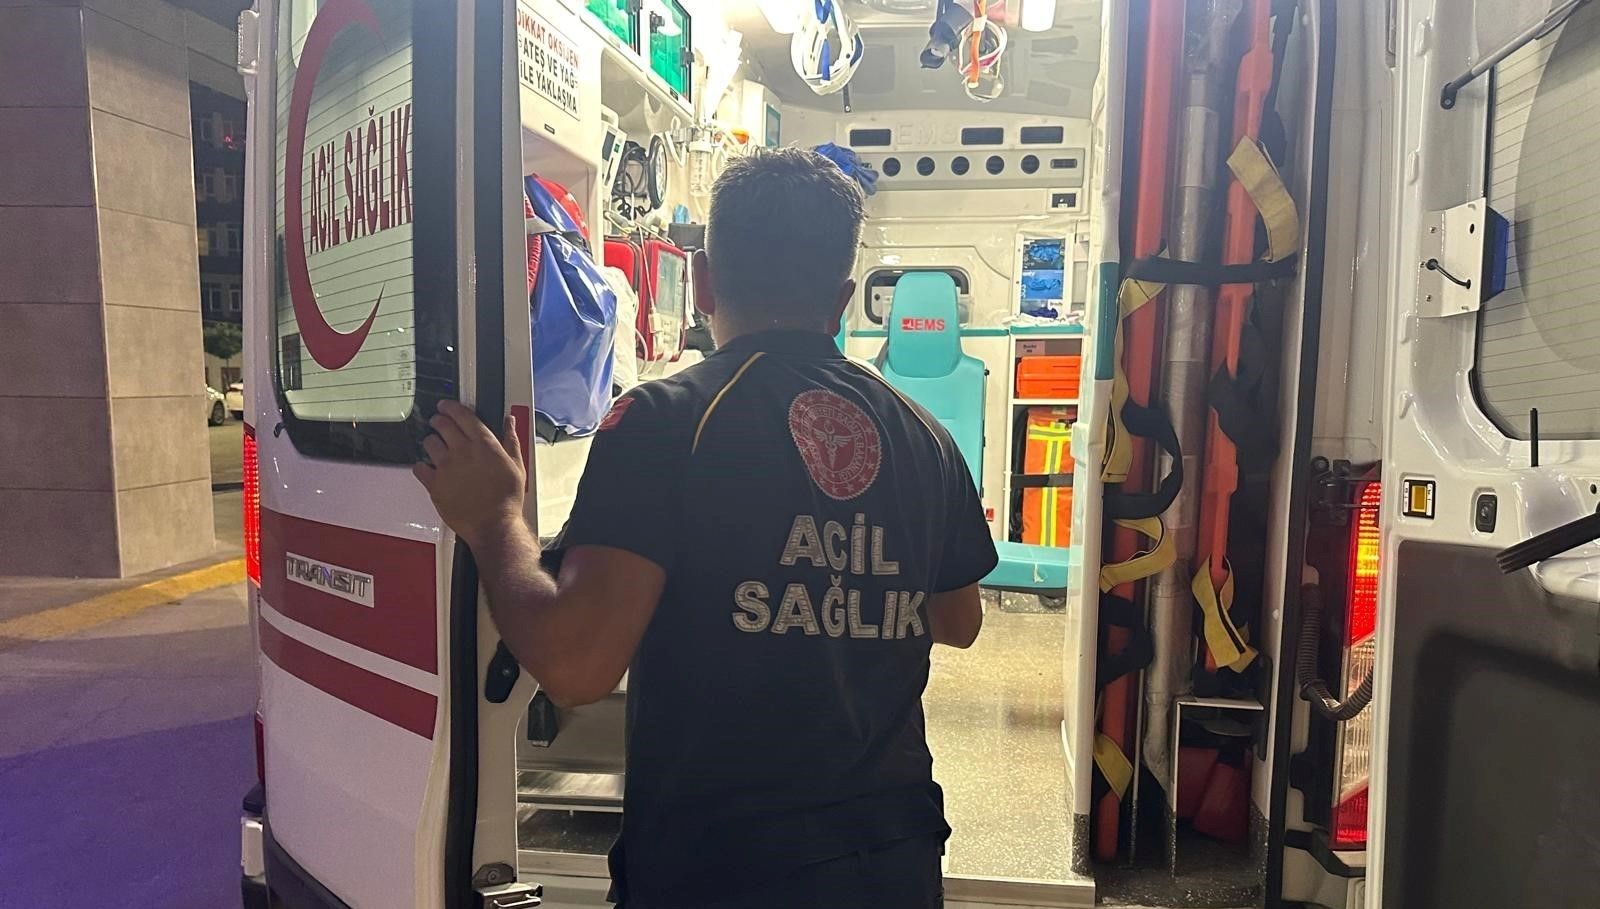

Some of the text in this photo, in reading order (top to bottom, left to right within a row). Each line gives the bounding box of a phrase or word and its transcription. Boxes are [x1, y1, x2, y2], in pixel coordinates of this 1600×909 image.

[520, 59, 578, 114] İLE YAKLAŞMA
[523, 37, 545, 73] ATEŞ
[547, 54, 558, 77] VE
[310, 104, 413, 255] ACİL SAĞLIK
[780, 512, 900, 576] ACİL
[286, 556, 372, 598] TRANSIT
[732, 574, 926, 640] SAĞLIK
